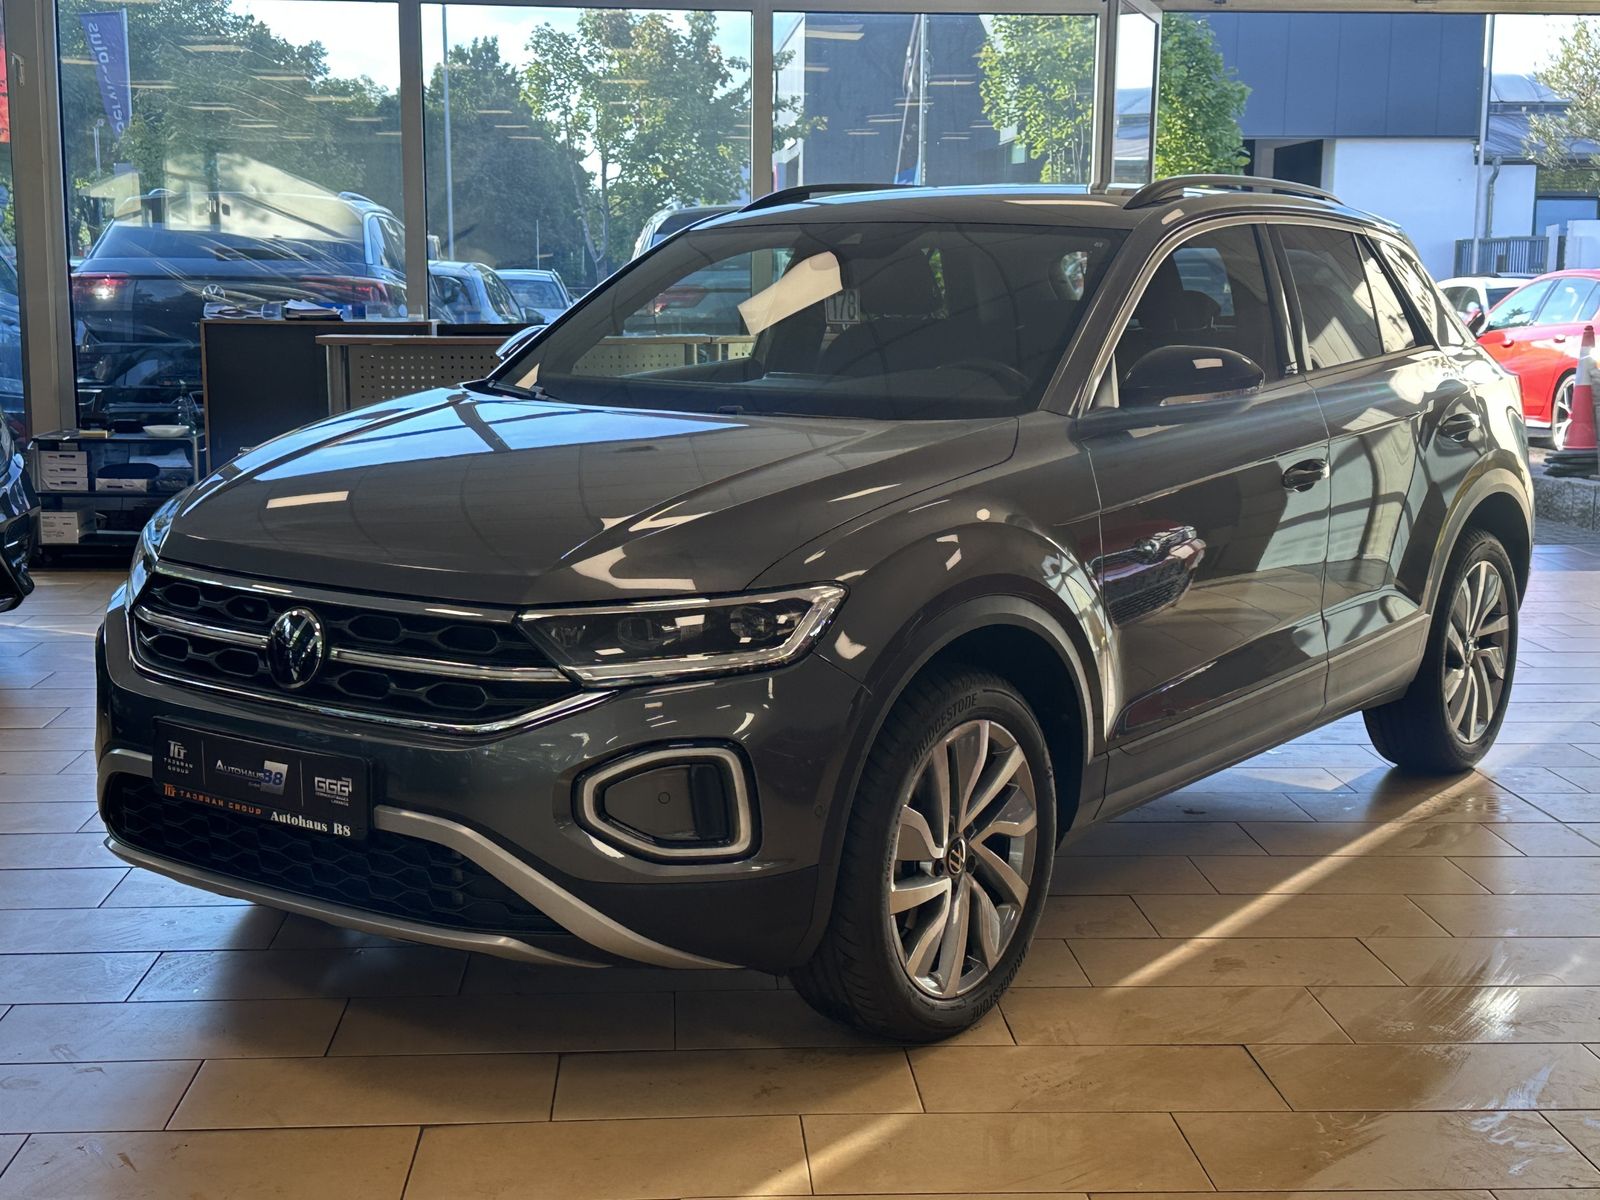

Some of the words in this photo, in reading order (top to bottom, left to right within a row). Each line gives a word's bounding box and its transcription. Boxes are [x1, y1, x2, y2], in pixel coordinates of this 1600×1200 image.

[912, 692, 978, 768] BRIDGESTONE
[314, 776, 352, 797] GGG
[270, 811, 328, 833] Autohaus
